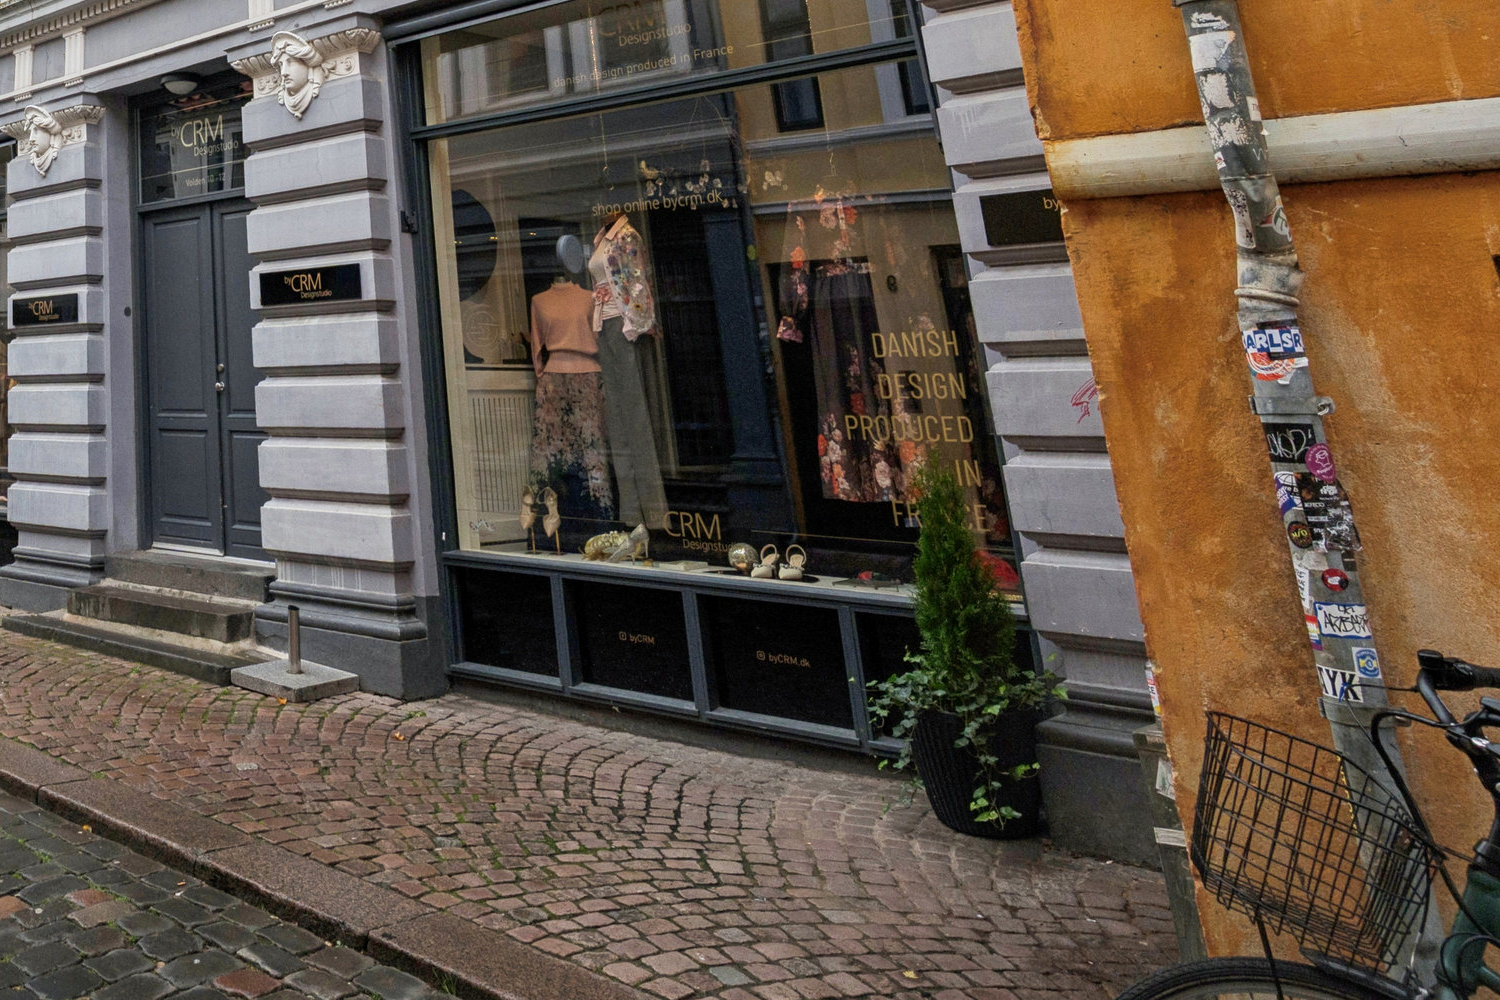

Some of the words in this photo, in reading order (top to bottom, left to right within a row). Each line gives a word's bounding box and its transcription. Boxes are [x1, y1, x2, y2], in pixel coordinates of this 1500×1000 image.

[618, 23, 692, 47] Designstudio
[554, 73, 587, 88] danish
[589, 67, 624, 81] design
[626, 53, 677, 75] produced
[680, 52, 690, 64] in
[693, 44, 734, 60] France
[193, 141, 239, 157] Designstudio
[185, 177, 205, 187] Volden
[591, 202, 620, 216] shop
[624, 197, 660, 213] online
[300, 290, 332, 299] Designstudio
[871, 330, 960, 359] DANISH
[877, 373, 967, 400] DESIGN
[844, 415, 974, 443] PRODUCED
[955, 459, 982, 488] IN
[891, 498, 992, 533] FRE
[682, 538, 736, 553] Designstud
[629, 634, 655, 645] byCRM
[769, 652, 811, 668] byCRM.dk
